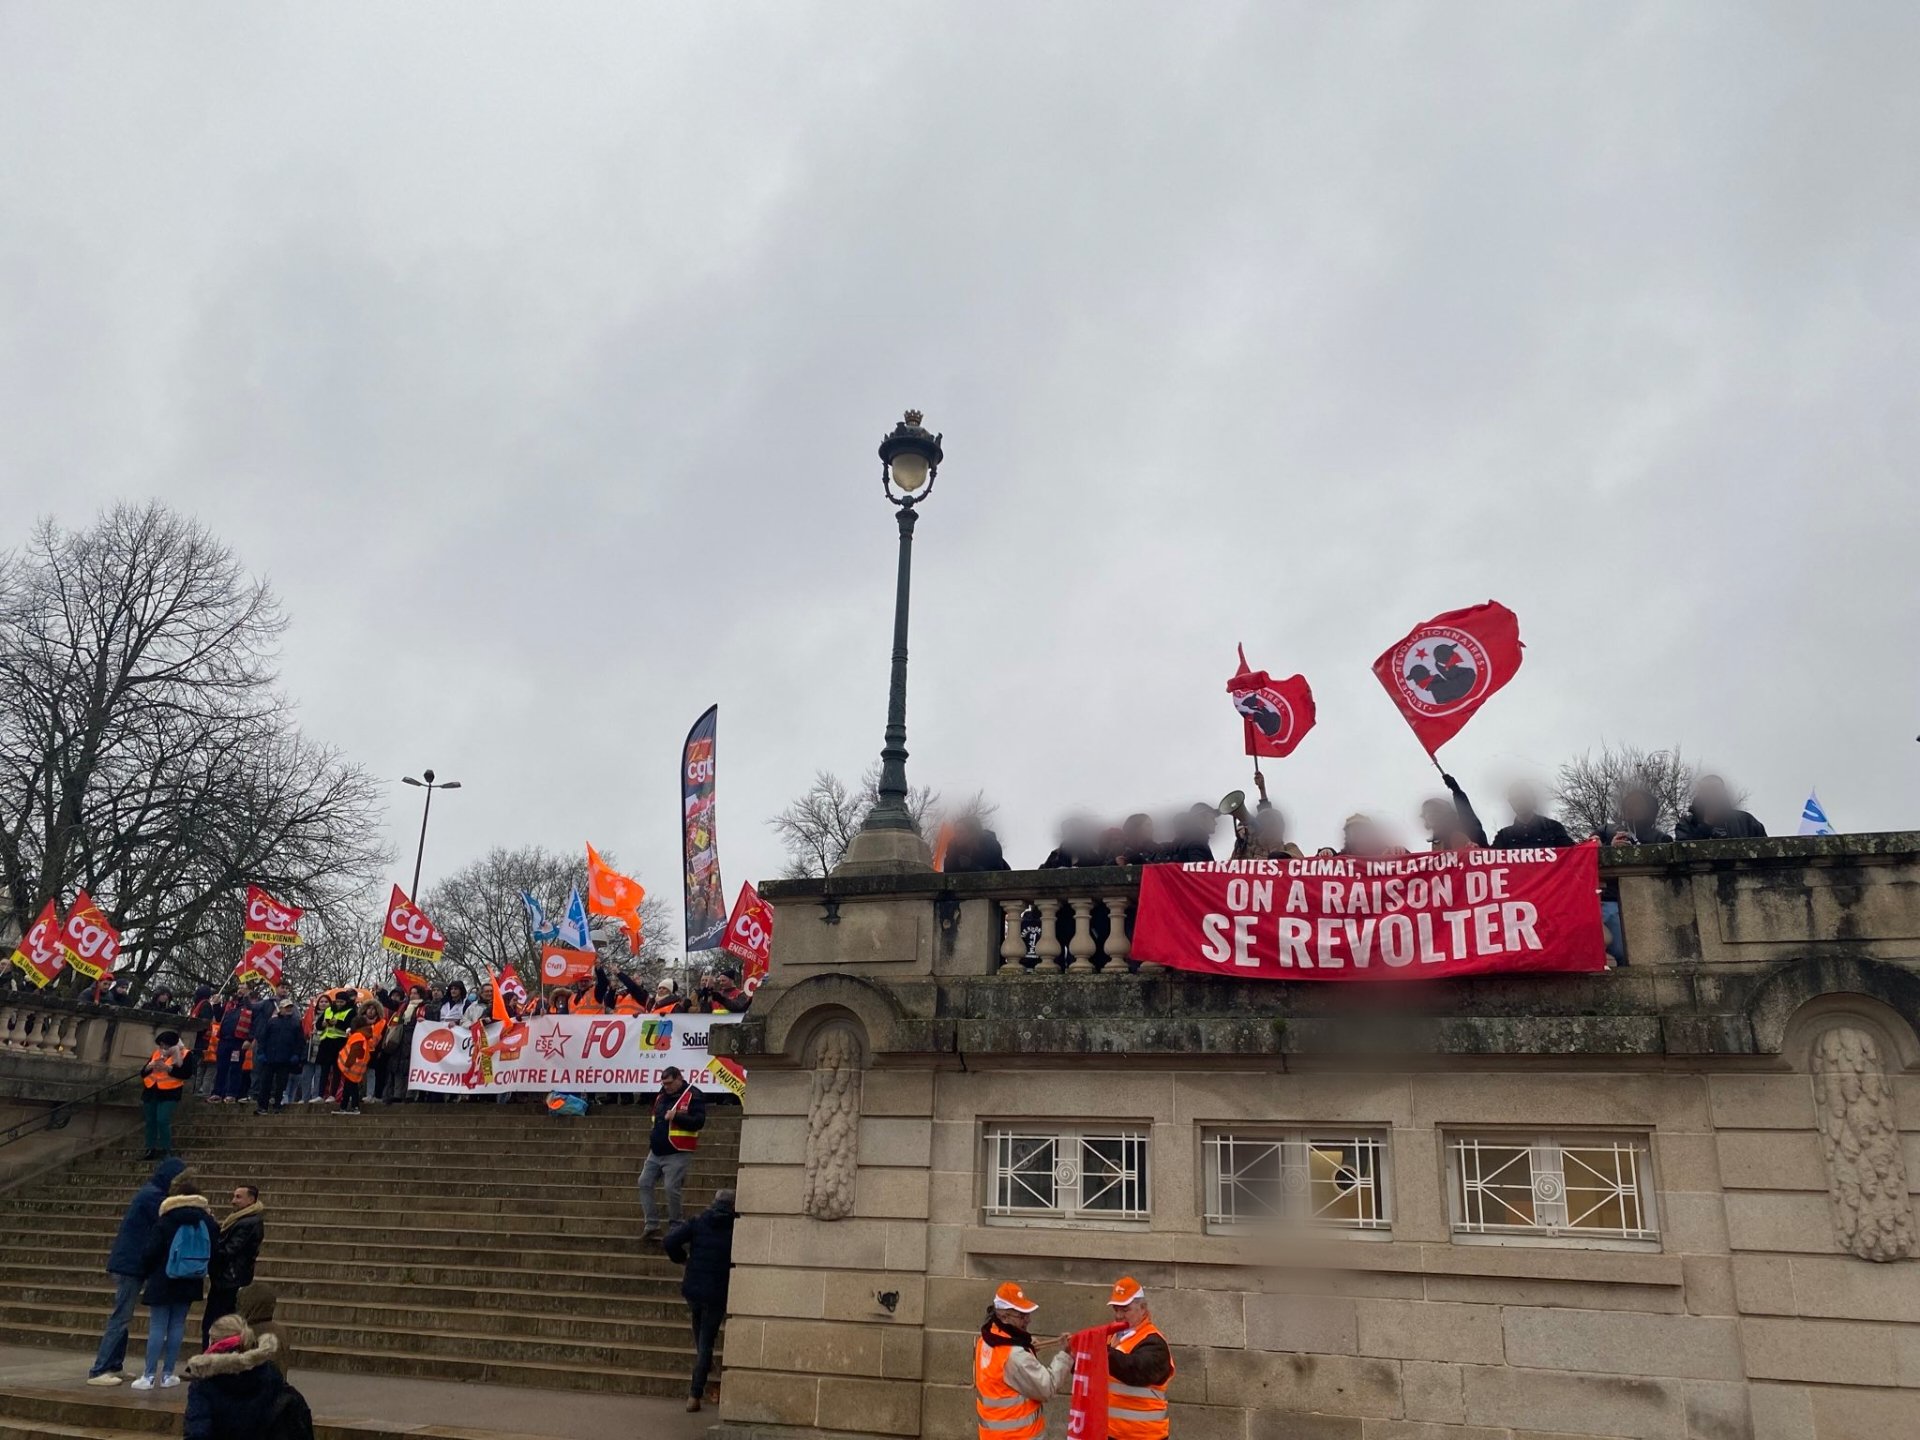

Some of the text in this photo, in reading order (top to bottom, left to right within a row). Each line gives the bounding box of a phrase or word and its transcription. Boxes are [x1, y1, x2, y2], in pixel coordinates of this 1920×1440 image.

[688, 755, 713, 782] cgt
[1288, 859, 1361, 879] CLIMAT,
[1367, 851, 1464, 876] INFLATION,
[1469, 847, 1558, 865] GUERRES
[1226, 868, 1510, 914] ON A RAISON DE
[389, 940, 434, 959] HAUTE-VIENNE
[1201, 901, 1543, 969] SE REVOLTER
[581, 1020, 626, 1059] FO
[494, 1069, 548, 1086] CONTRE
[551, 1069, 571, 1084] LA
[575, 1066, 649, 1084] RÉFORME
